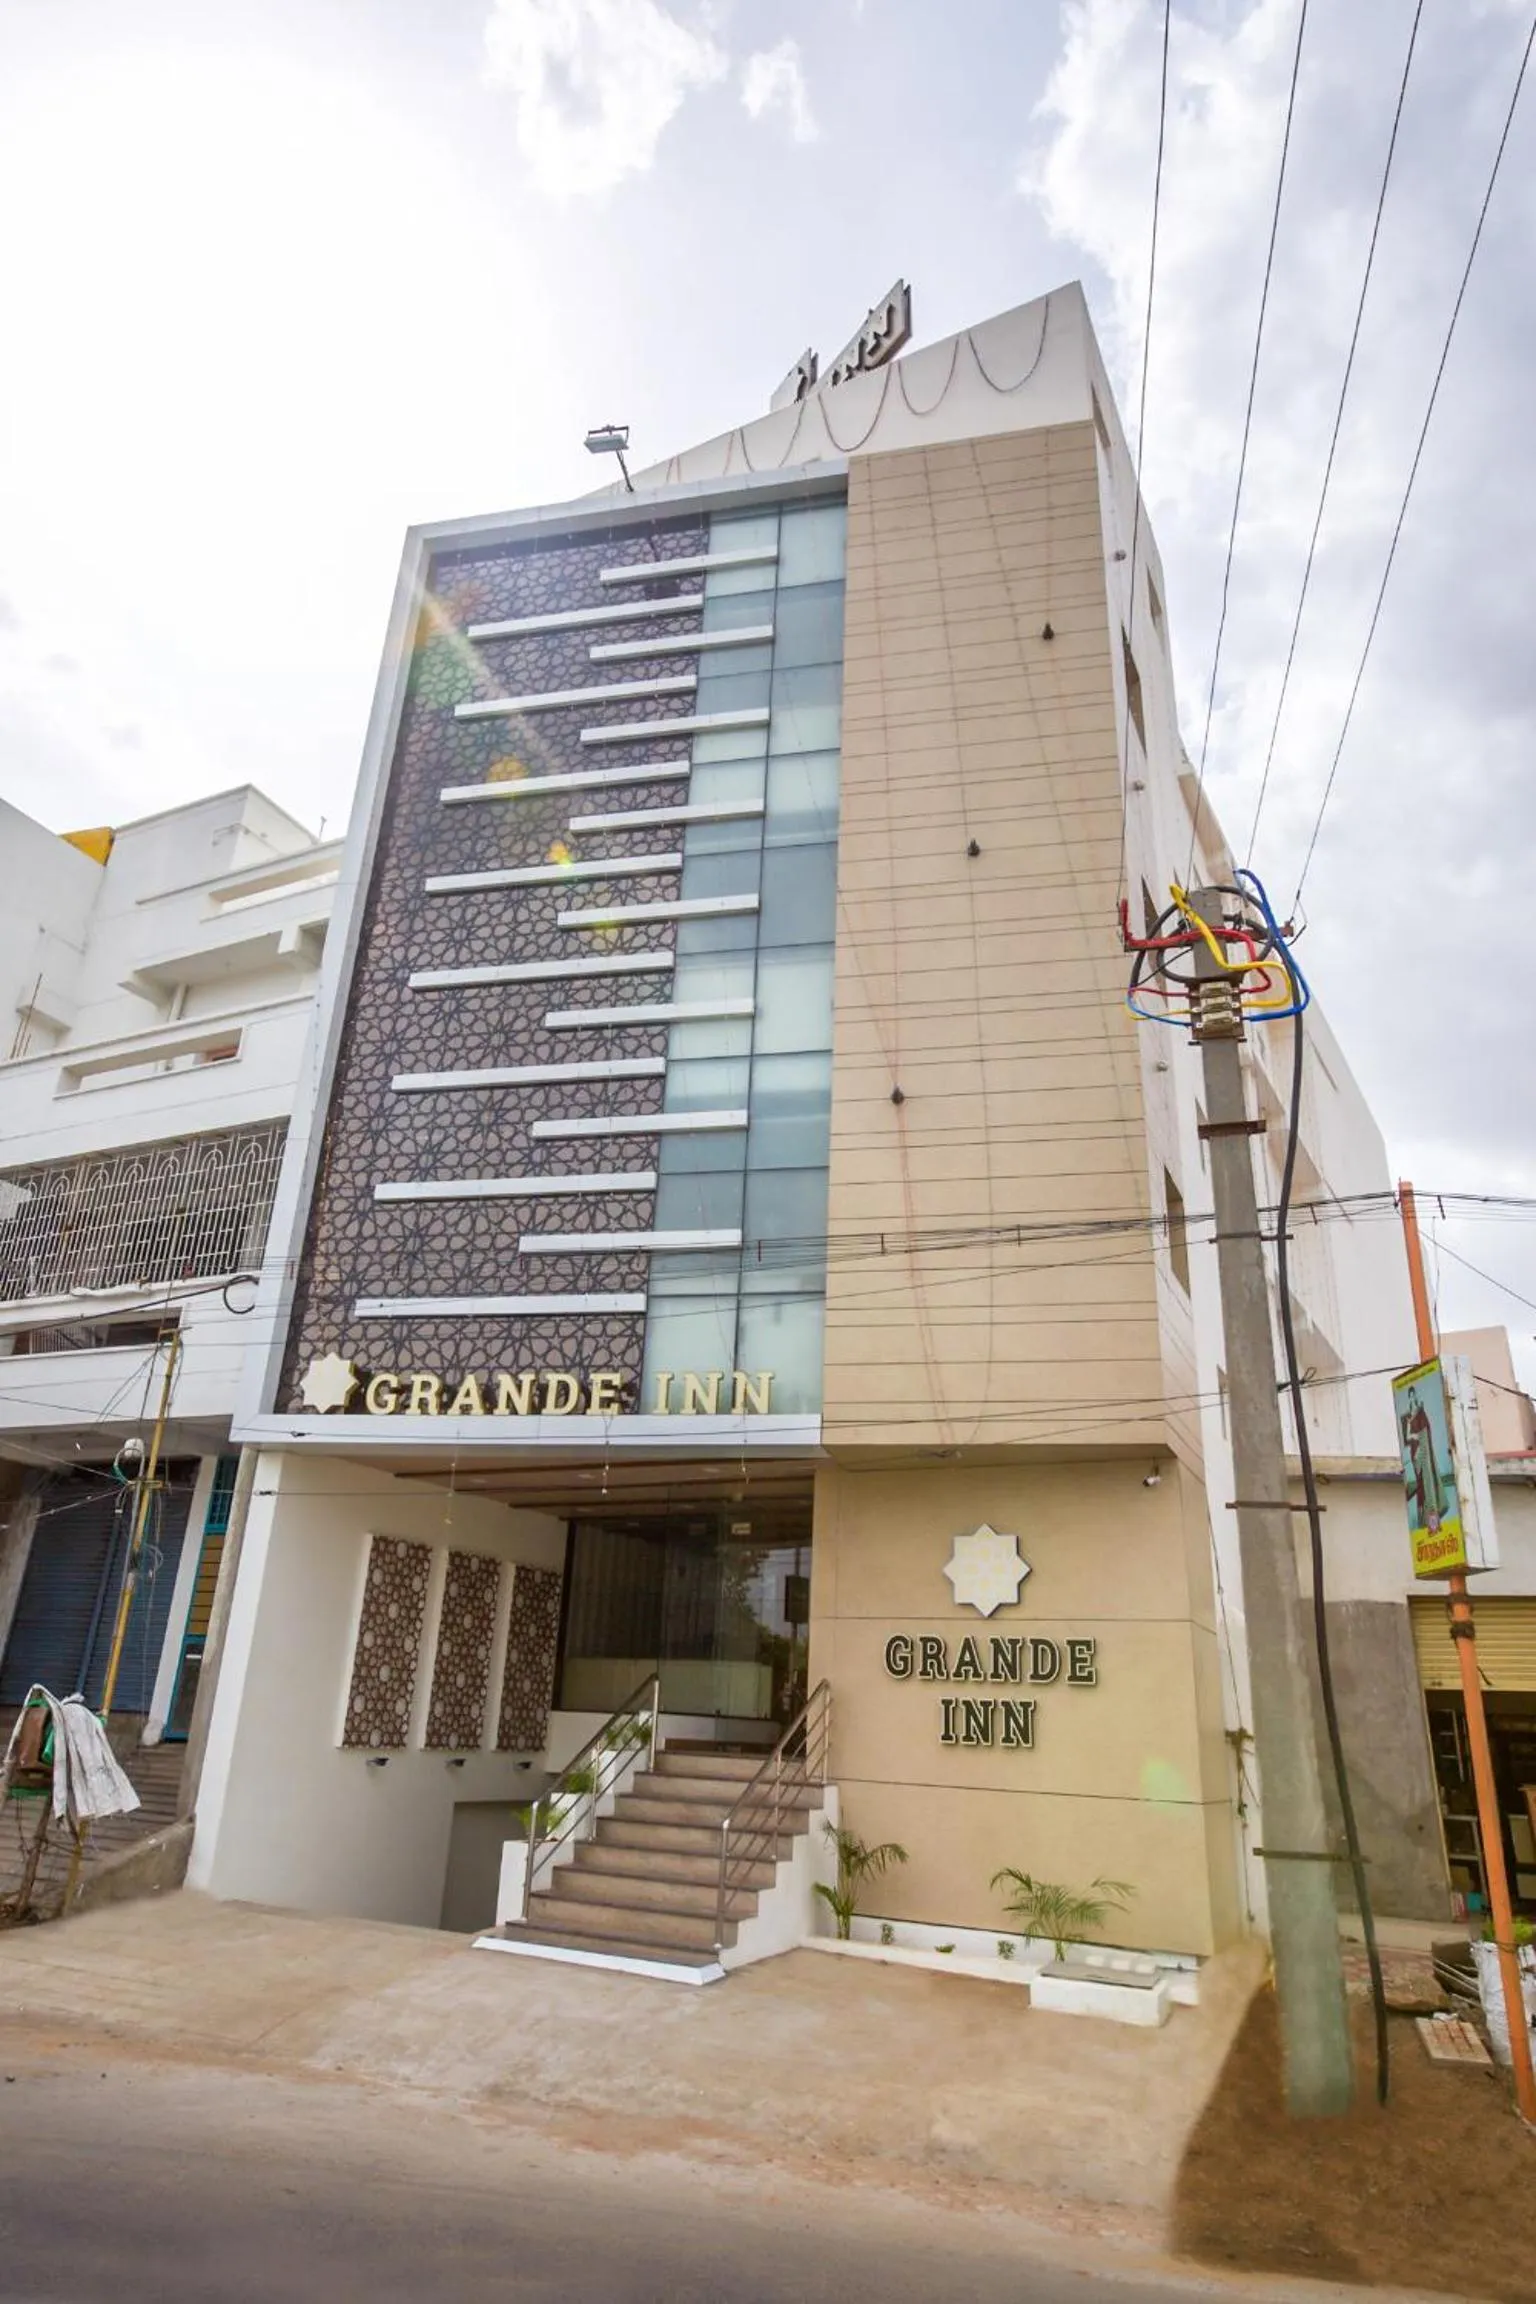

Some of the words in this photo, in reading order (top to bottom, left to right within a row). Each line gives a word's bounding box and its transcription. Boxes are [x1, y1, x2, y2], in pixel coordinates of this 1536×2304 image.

[365, 1373, 623, 1416] GRANDE
[653, 1370, 776, 1415] INN
[884, 1633, 1097, 1685] GRANDE
[940, 1696, 1036, 1748] INN
